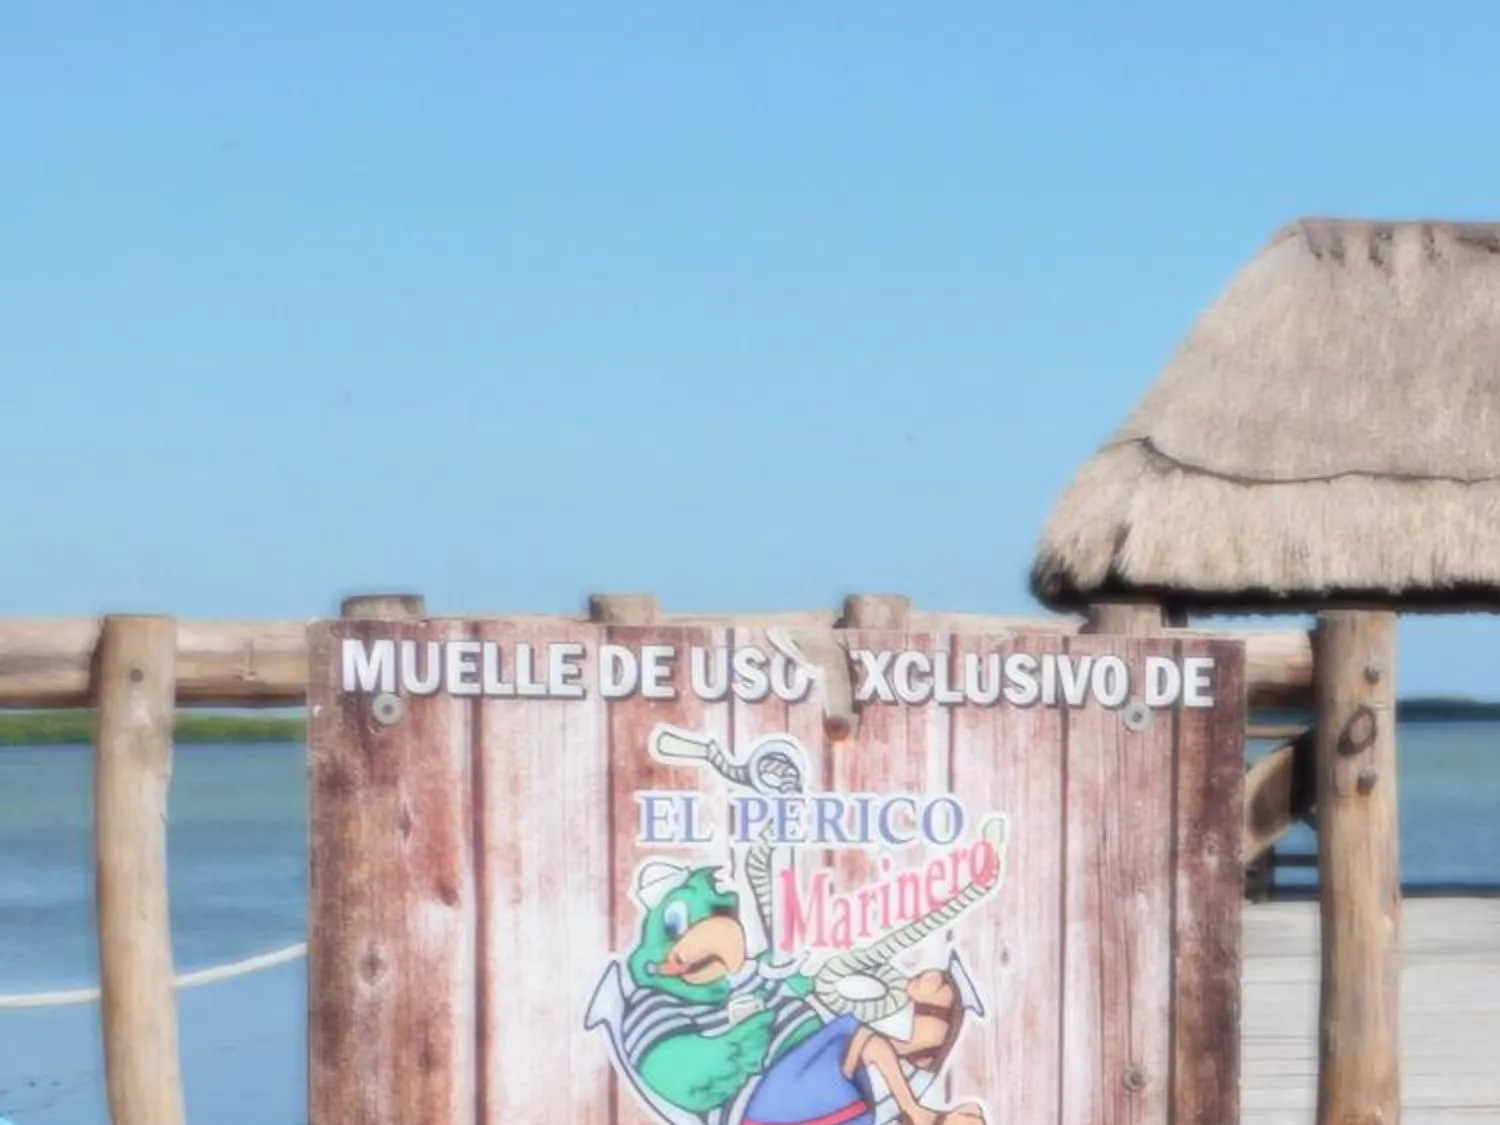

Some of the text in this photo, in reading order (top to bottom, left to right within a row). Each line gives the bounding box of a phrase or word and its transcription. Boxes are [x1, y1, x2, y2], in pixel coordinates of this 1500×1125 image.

[340, 637, 585, 698] MUELLE
[600, 643, 678, 698] DE
[850, 647, 1130, 708] XCLUSIVO
[1144, 655, 1217, 708] DE
[638, 794, 964, 846] EL PERICO
[779, 837, 1001, 953] Marinero
